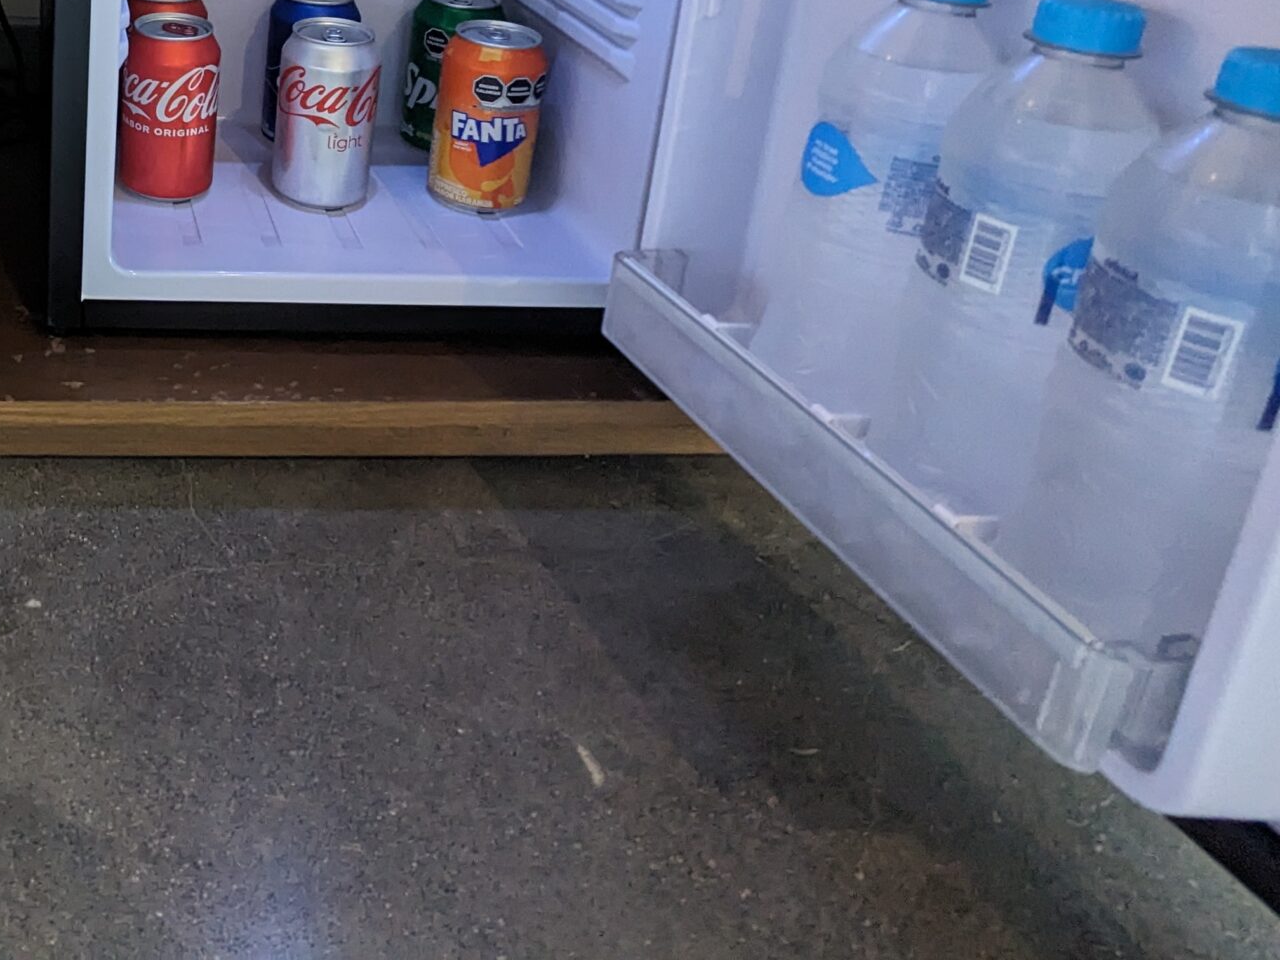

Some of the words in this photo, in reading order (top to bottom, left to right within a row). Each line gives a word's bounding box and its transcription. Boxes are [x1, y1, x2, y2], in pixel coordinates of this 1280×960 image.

[123, 64, 219, 123] ca-Col
[153, 125, 209, 137] ORIGINAL
[452, 110, 527, 143] FANTA
[327, 132, 362, 152] light
